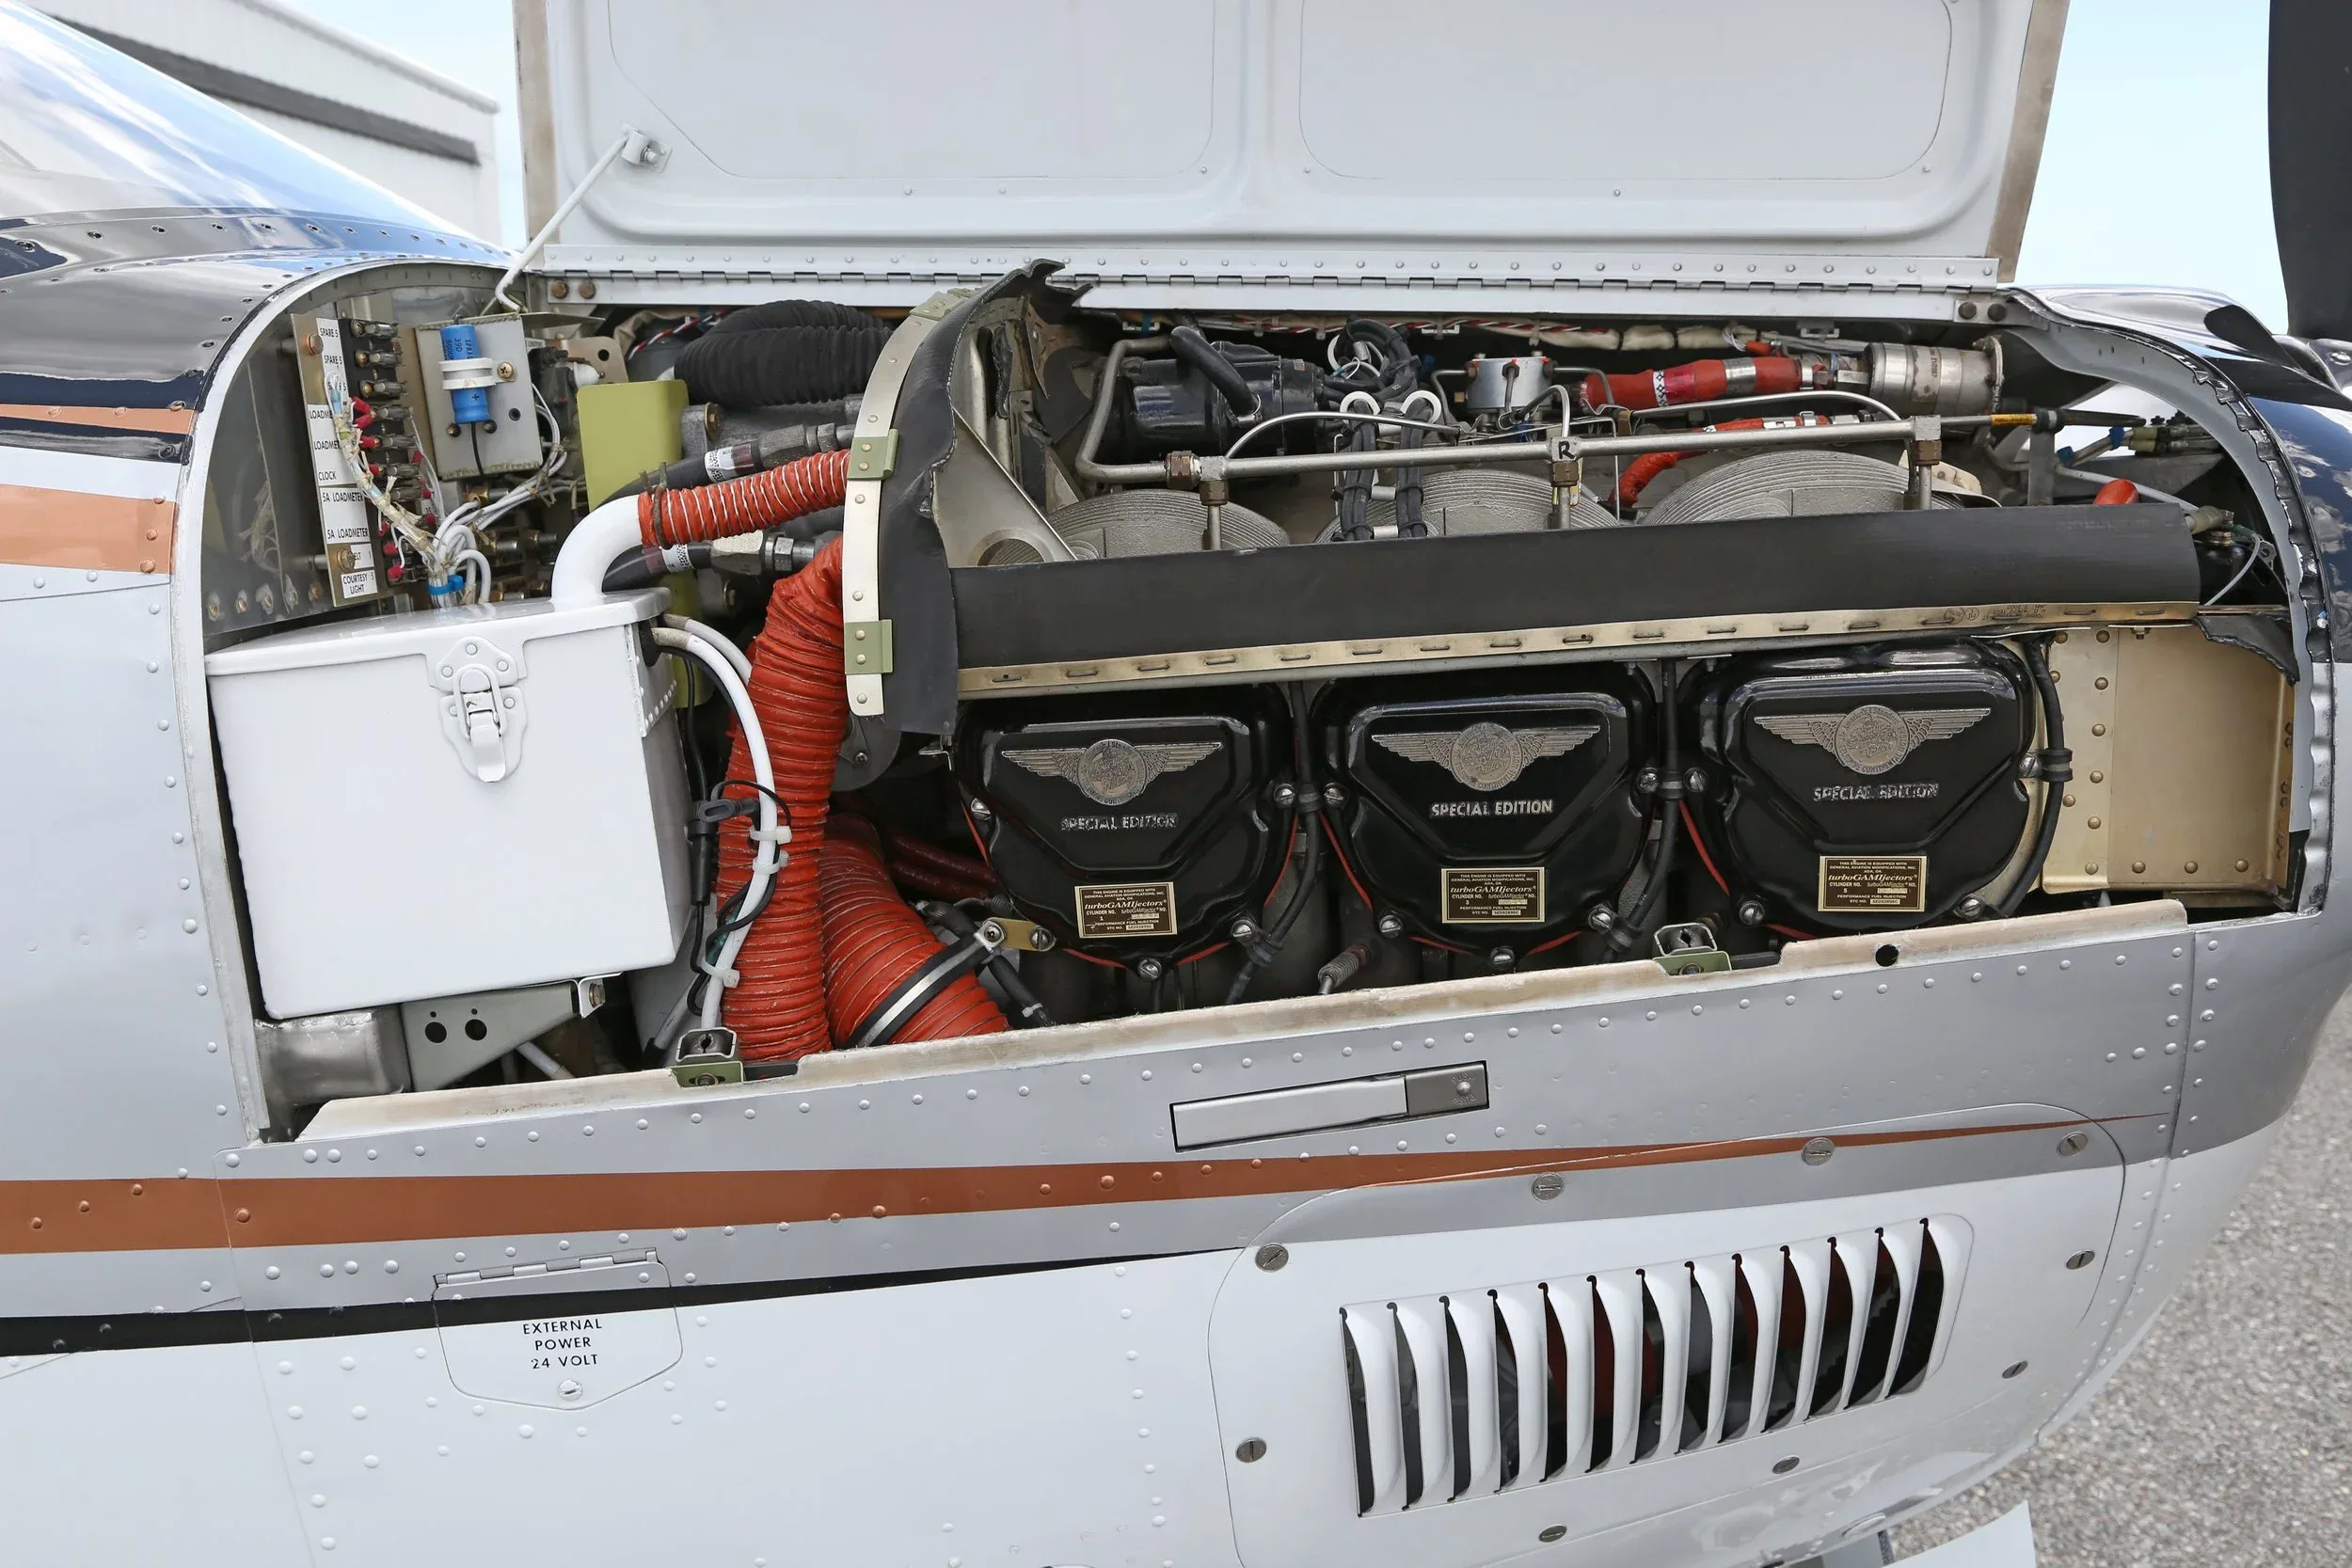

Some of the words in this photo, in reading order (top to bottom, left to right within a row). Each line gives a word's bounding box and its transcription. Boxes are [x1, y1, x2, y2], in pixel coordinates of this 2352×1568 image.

[320, 328, 334, 337] SPARE
[324, 356, 338, 364] SPARE
[310, 410, 333, 419] LOADME
[314, 440, 341, 450] LOADMET
[1558, 440, 1576, 460] R
[319, 471, 337, 481] CLOCK
[323, 493, 329, 502] 5A
[333, 492, 364, 501] LOADMETER
[327, 531, 335, 539] 5A
[338, 528, 368, 538] LOADMETER
[343, 574, 367, 584] COURTESY
[349, 585, 364, 594] LIGHT
[1814, 785, 1873, 801] SPECIAL
[1879, 784, 1938, 799] EDITION
[1431, 802, 1490, 817] SPECIAL
[1495, 800, 1552, 816] EDITION
[1060, 816, 1117, 832] SPECIAL
[1122, 813, 1177, 828] EDITION
[1452, 1072, 1475, 1084] PUSH
[523, 1319, 602, 1334] EXTERNAL
[535, 1337, 591, 1351] POWER
[531, 1357, 549, 1369] 24
[558, 1354, 597, 1367] VOLT
